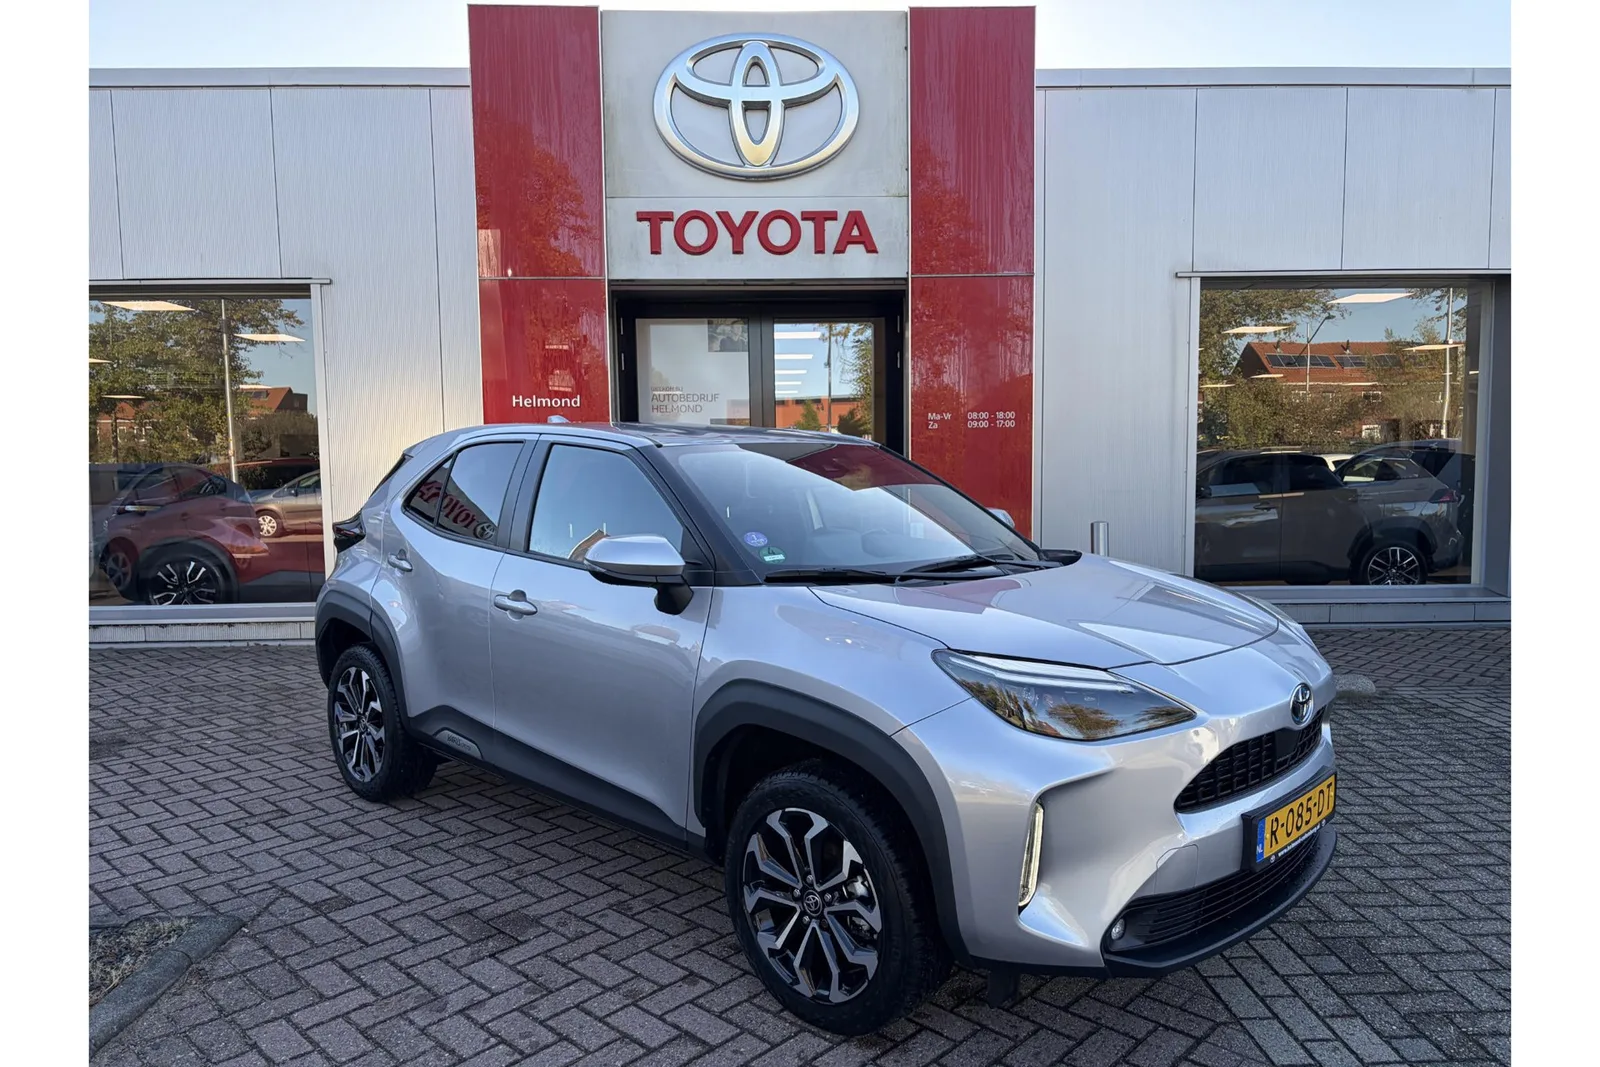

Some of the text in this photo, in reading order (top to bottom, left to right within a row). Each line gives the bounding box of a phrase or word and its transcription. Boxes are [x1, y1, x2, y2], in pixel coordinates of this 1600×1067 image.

[636, 209, 879, 256] TOYOTA
[512, 394, 581, 408] Helmond
[651, 393, 720, 403] AUTOBEDRIJF
[651, 404, 703, 414] HELMOND
[928, 412, 952, 421] Ma-Vr
[967, 411, 989, 420] 08:00
[995, 411, 1016, 420] 18:00
[928, 421, 938, 429] Za
[967, 420, 989, 429] 09:00
[995, 420, 1016, 429] 17:00
[1269, 781, 1333, 849] R-085-DT
[1256, 843, 1263, 853] NL
